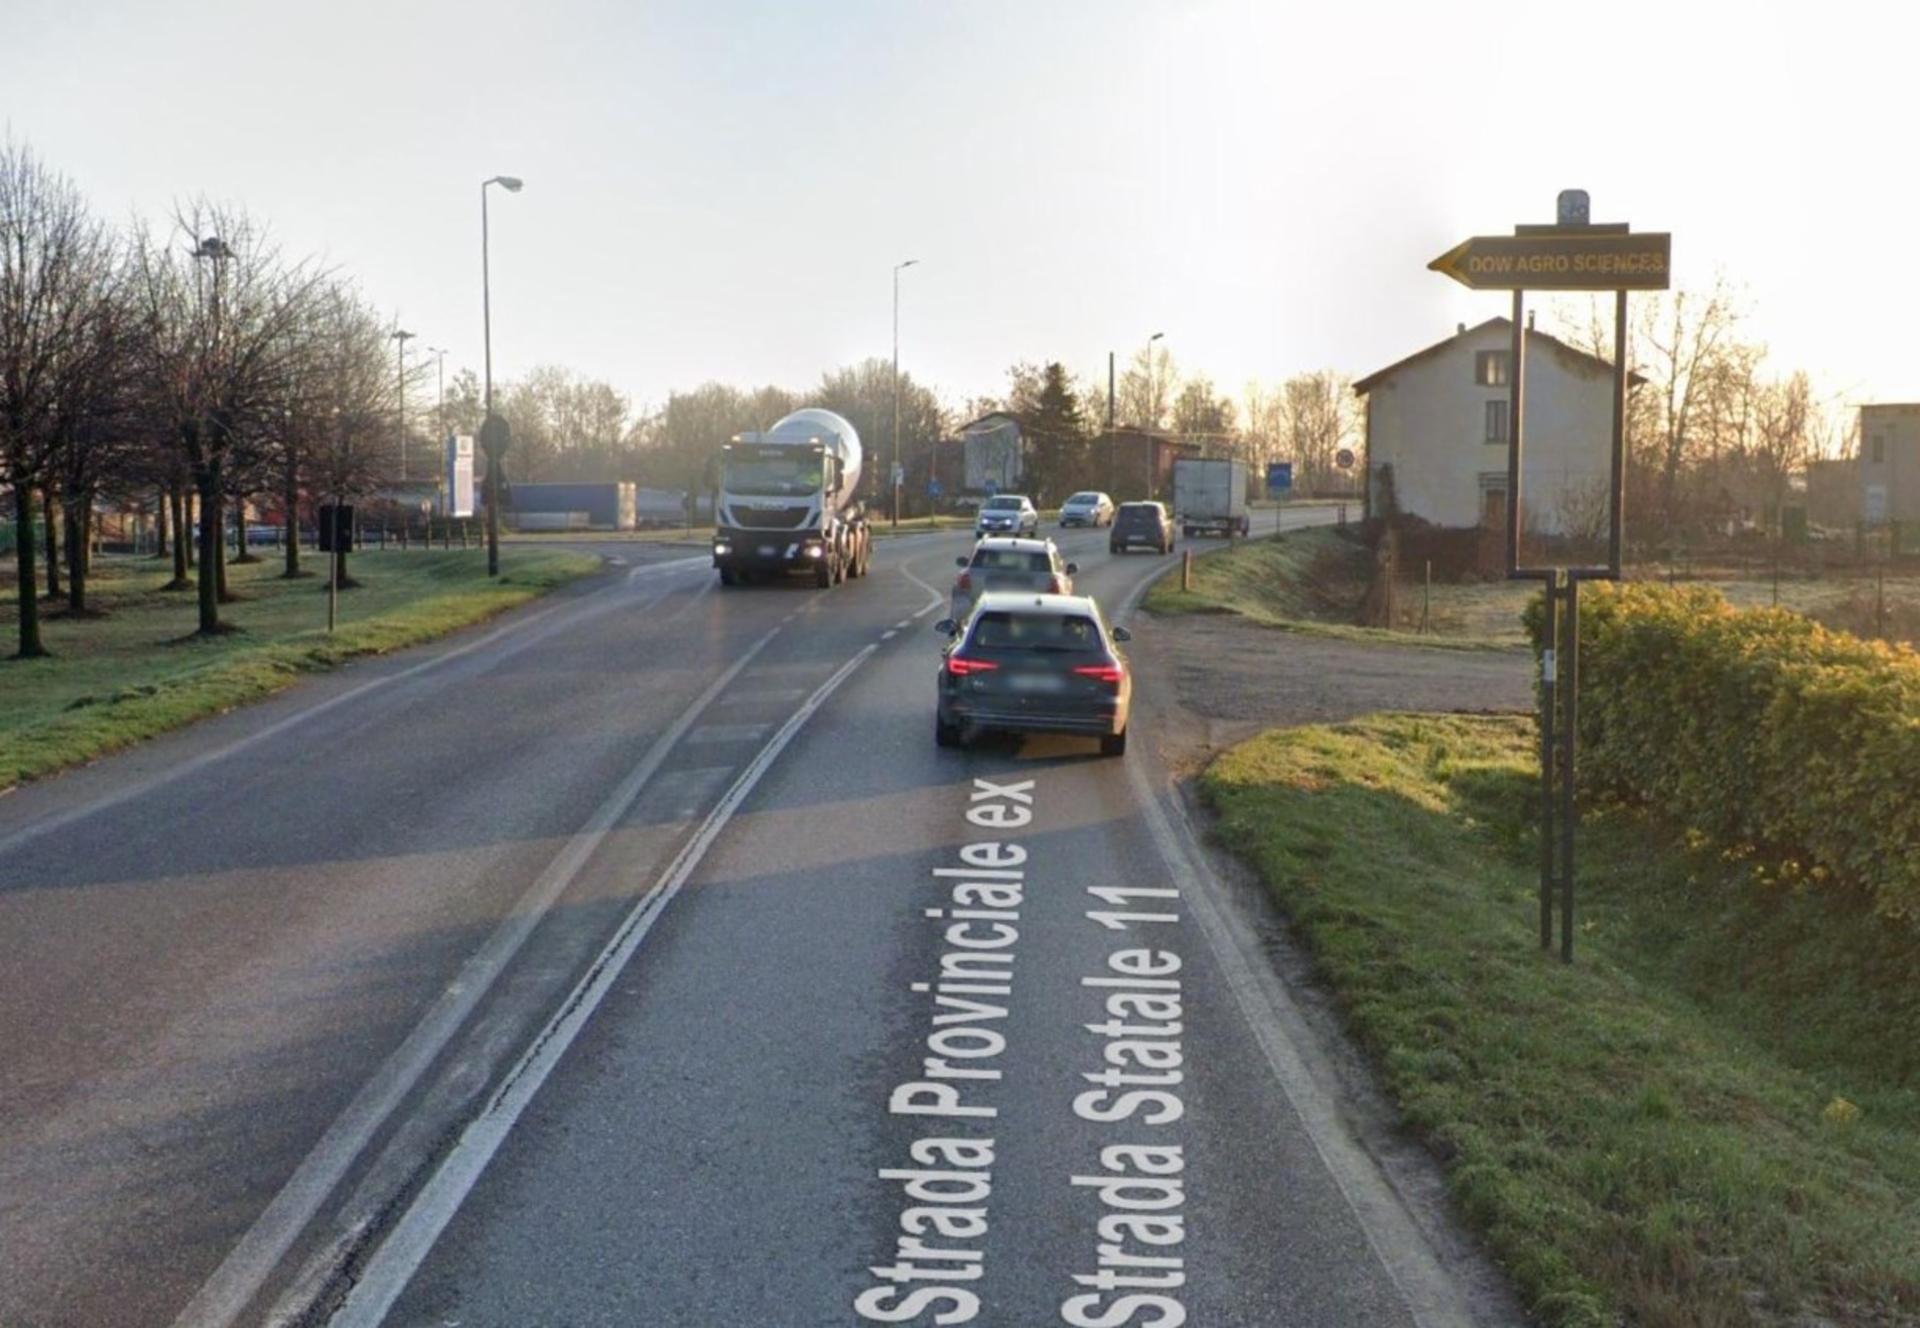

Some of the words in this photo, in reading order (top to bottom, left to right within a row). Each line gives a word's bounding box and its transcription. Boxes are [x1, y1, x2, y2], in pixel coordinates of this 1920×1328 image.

[1470, 256, 1512, 273] DOW
[1516, 255, 1569, 272] AGRO
[1574, 253, 1665, 273] SCIENCES
